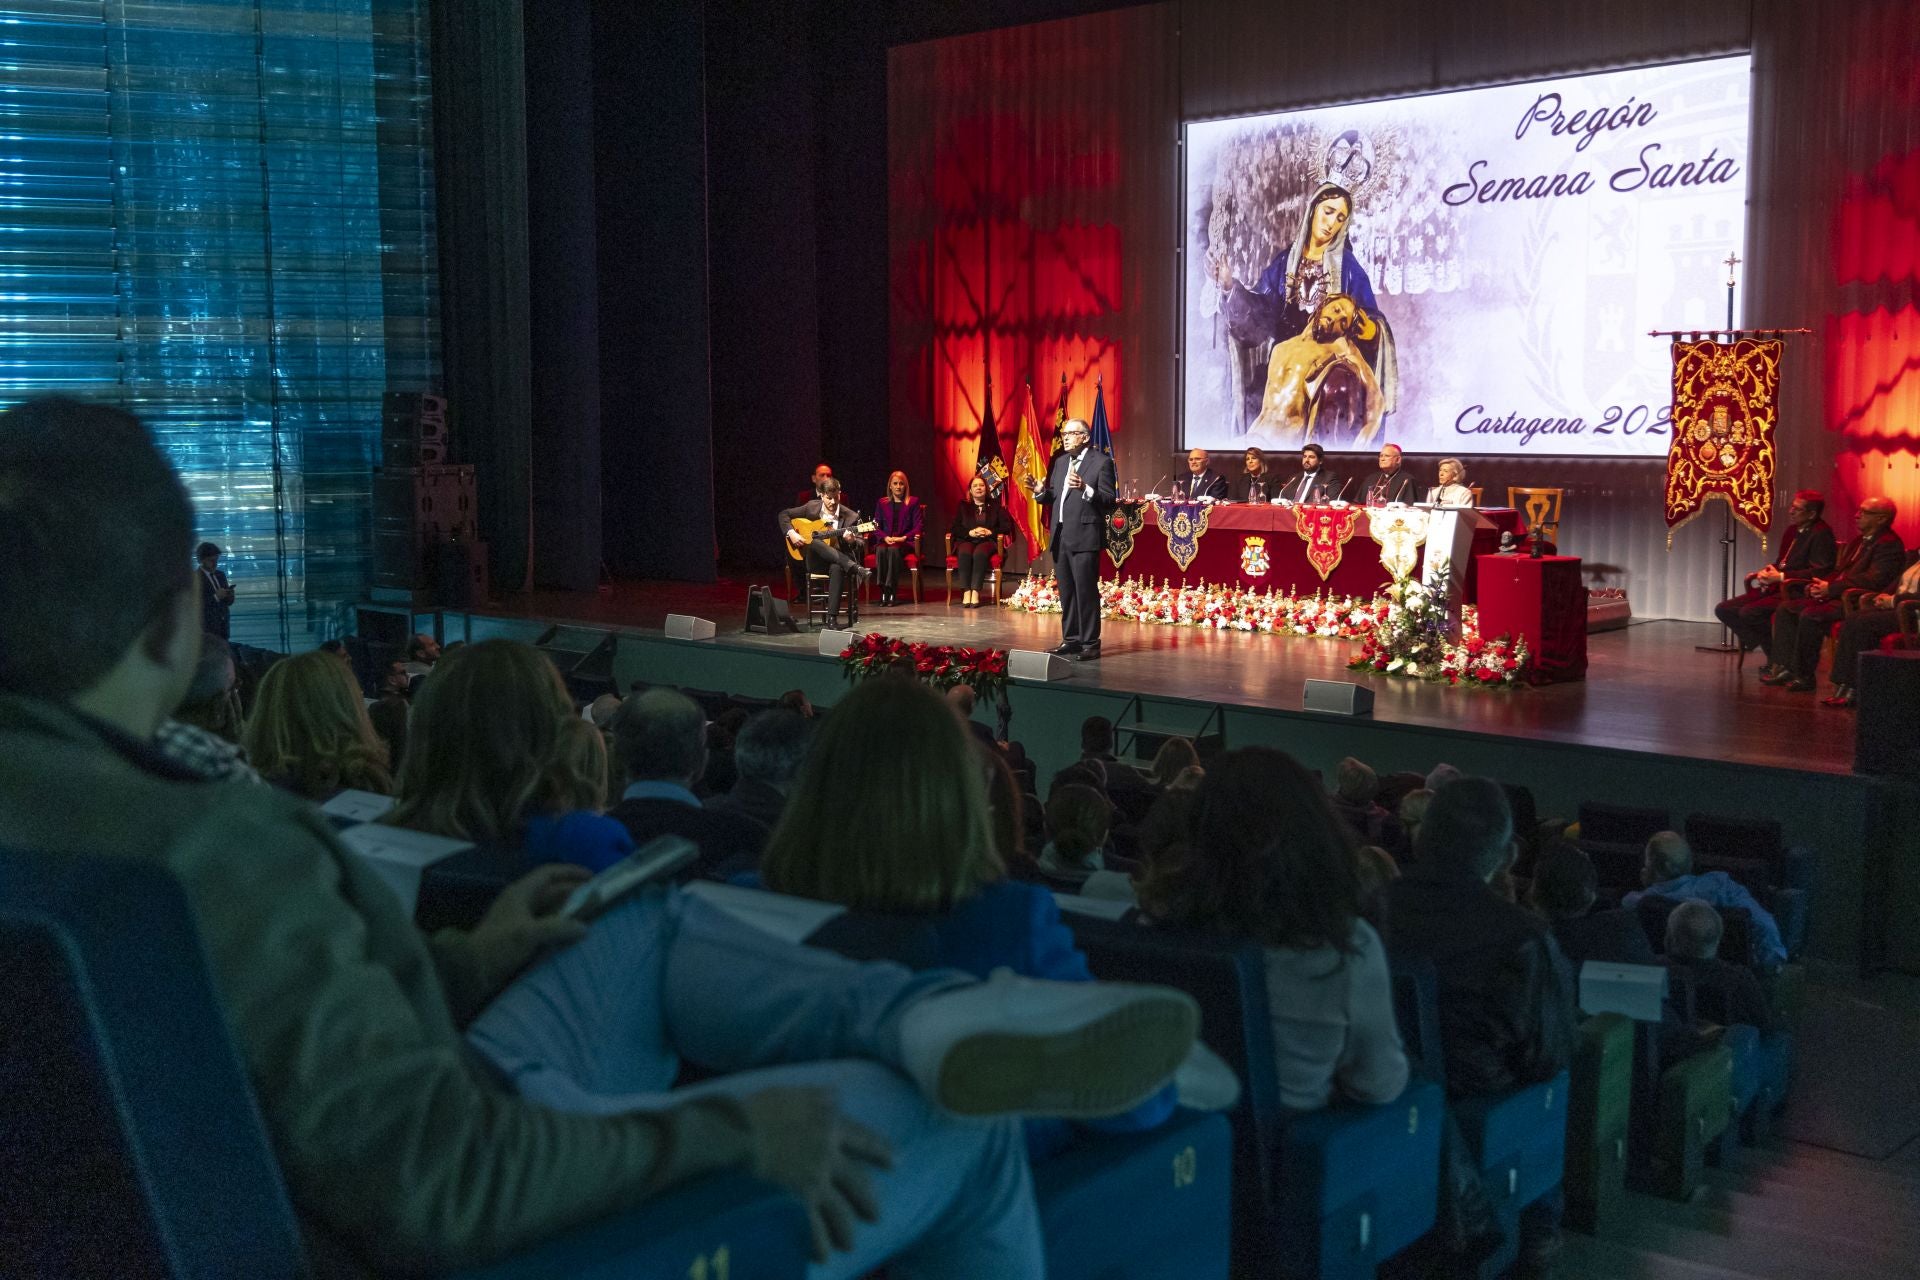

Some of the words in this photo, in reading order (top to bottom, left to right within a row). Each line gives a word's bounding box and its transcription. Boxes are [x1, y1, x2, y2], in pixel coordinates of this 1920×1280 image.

[1514, 92, 1658, 152] Pregón
[1441, 159, 1596, 207] Semana
[1609, 142, 1741, 193] Santa
[1454, 404, 1586, 446] Cartagena
[1592, 404, 1672, 435] 202
